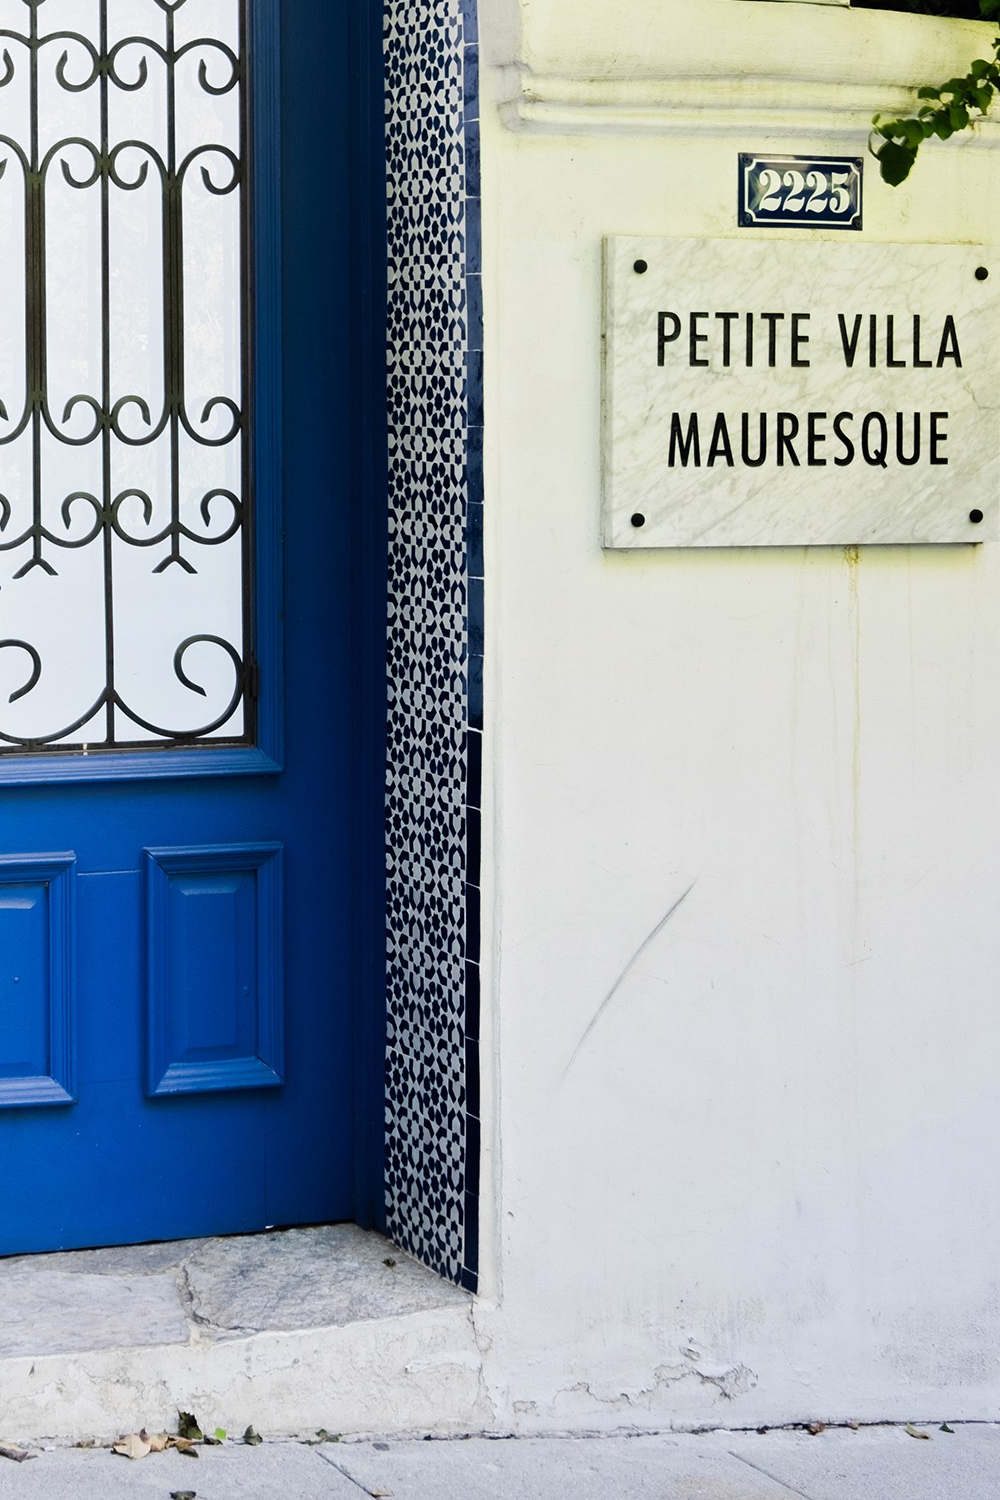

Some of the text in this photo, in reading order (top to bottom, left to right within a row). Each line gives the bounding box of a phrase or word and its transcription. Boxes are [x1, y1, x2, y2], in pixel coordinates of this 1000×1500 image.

[759, 169, 850, 213] 2225
[657, 311, 963, 368] PETITE VILLA
[667, 411, 949, 469] MAURESQUE
